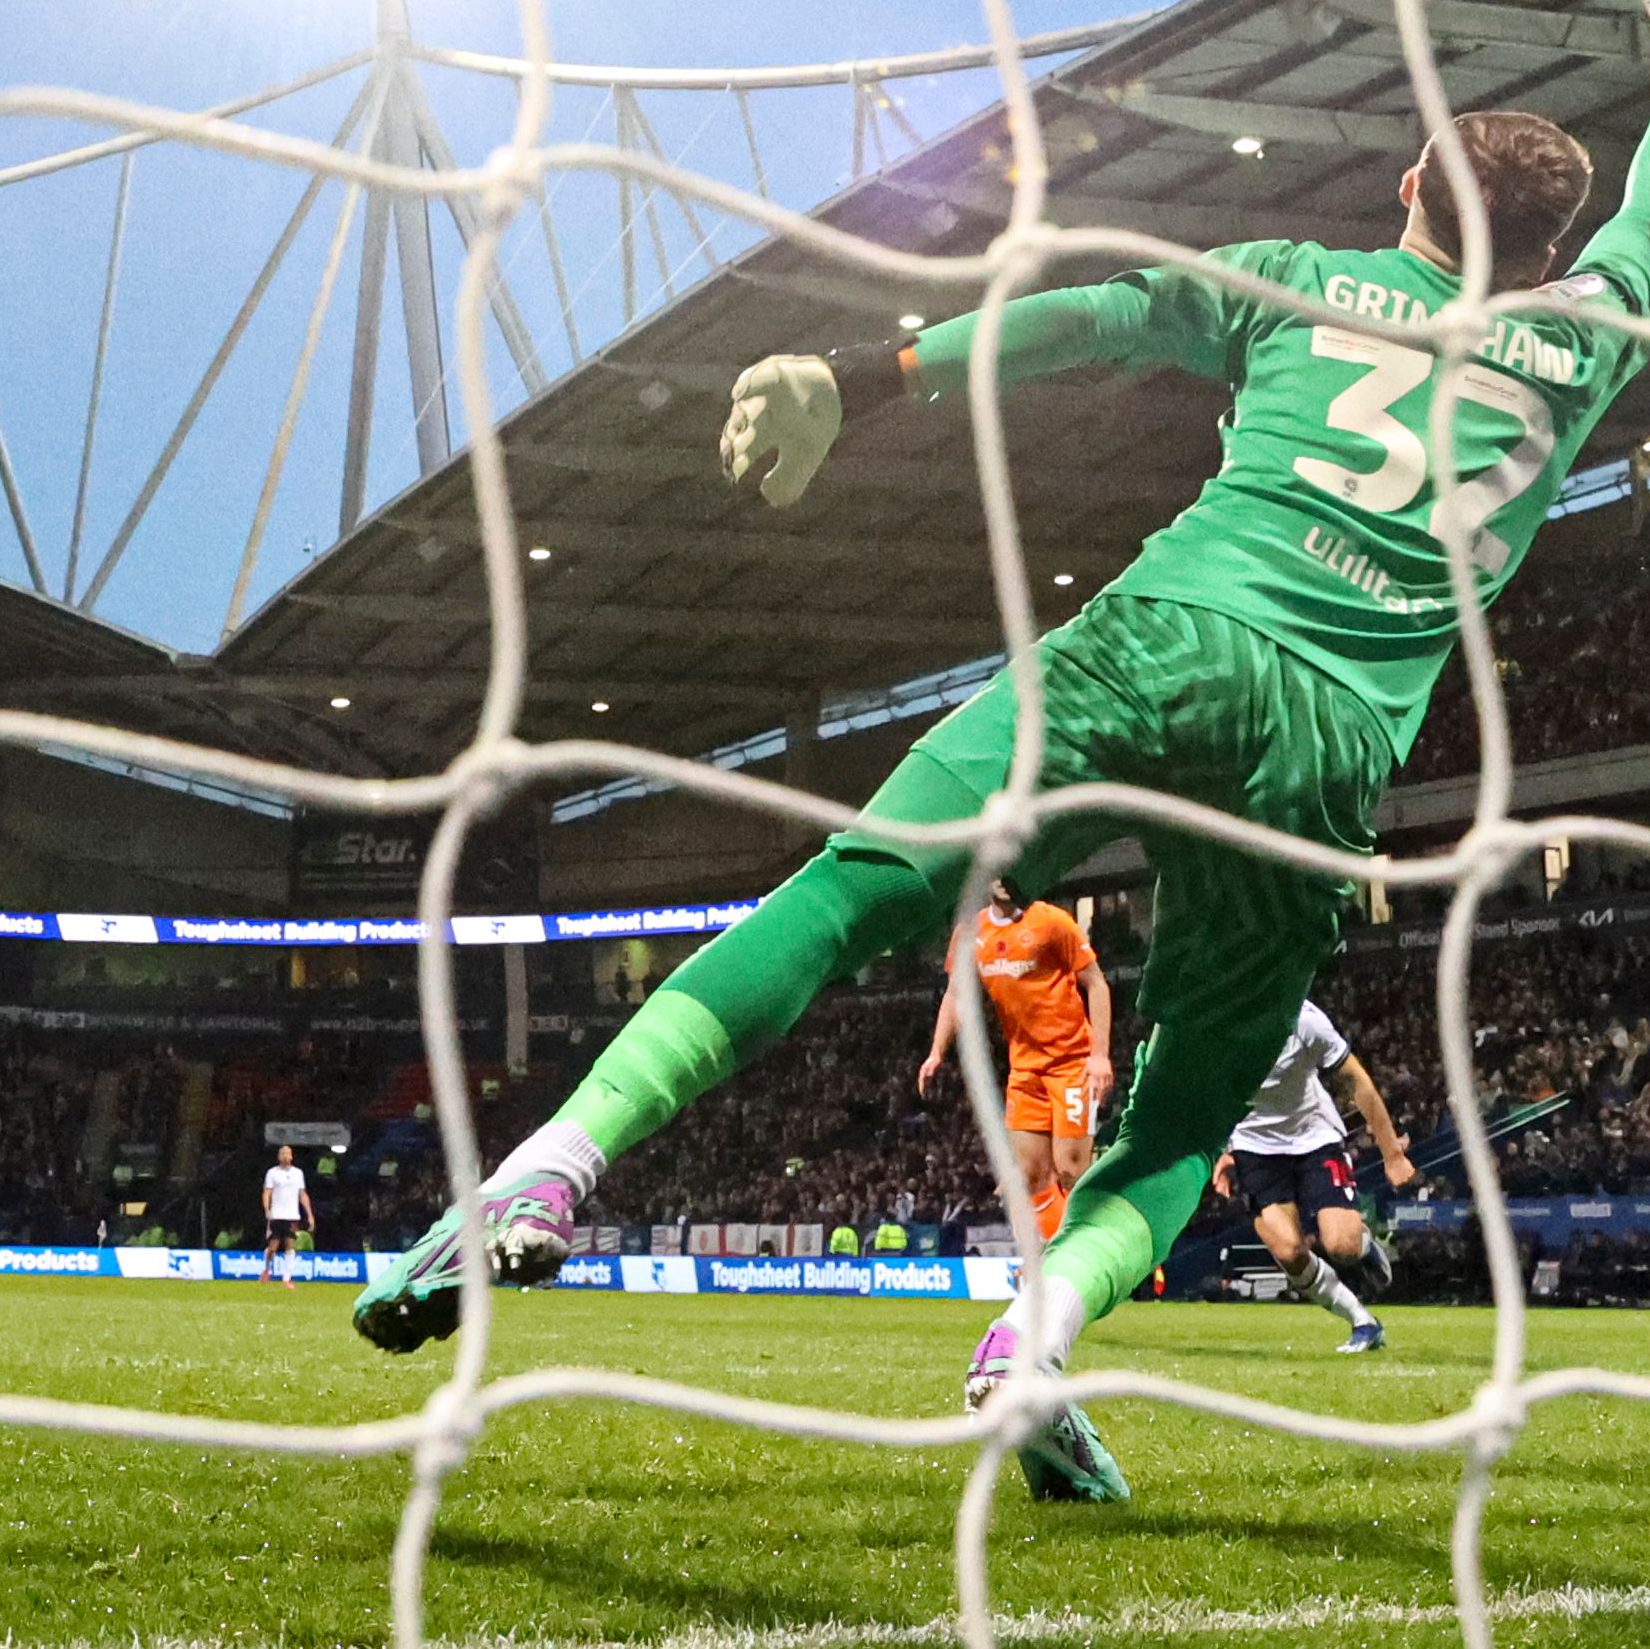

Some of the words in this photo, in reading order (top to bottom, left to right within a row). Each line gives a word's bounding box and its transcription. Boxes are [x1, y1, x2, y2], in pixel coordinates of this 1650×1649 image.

[173, 920, 281, 943] Toughsheet
[284, 922, 357, 947] Building
[359, 921, 434, 942] Product
[557, 913, 641, 937] Toughsheet
[643, 907, 706, 931] Building
[1063, 1087, 1085, 1126] 5
[555, 1262, 612, 1285] roducts
[711, 1262, 800, 1292] Toughsheet
[804, 1262, 871, 1294] Building
[874, 1264, 950, 1291] Products
